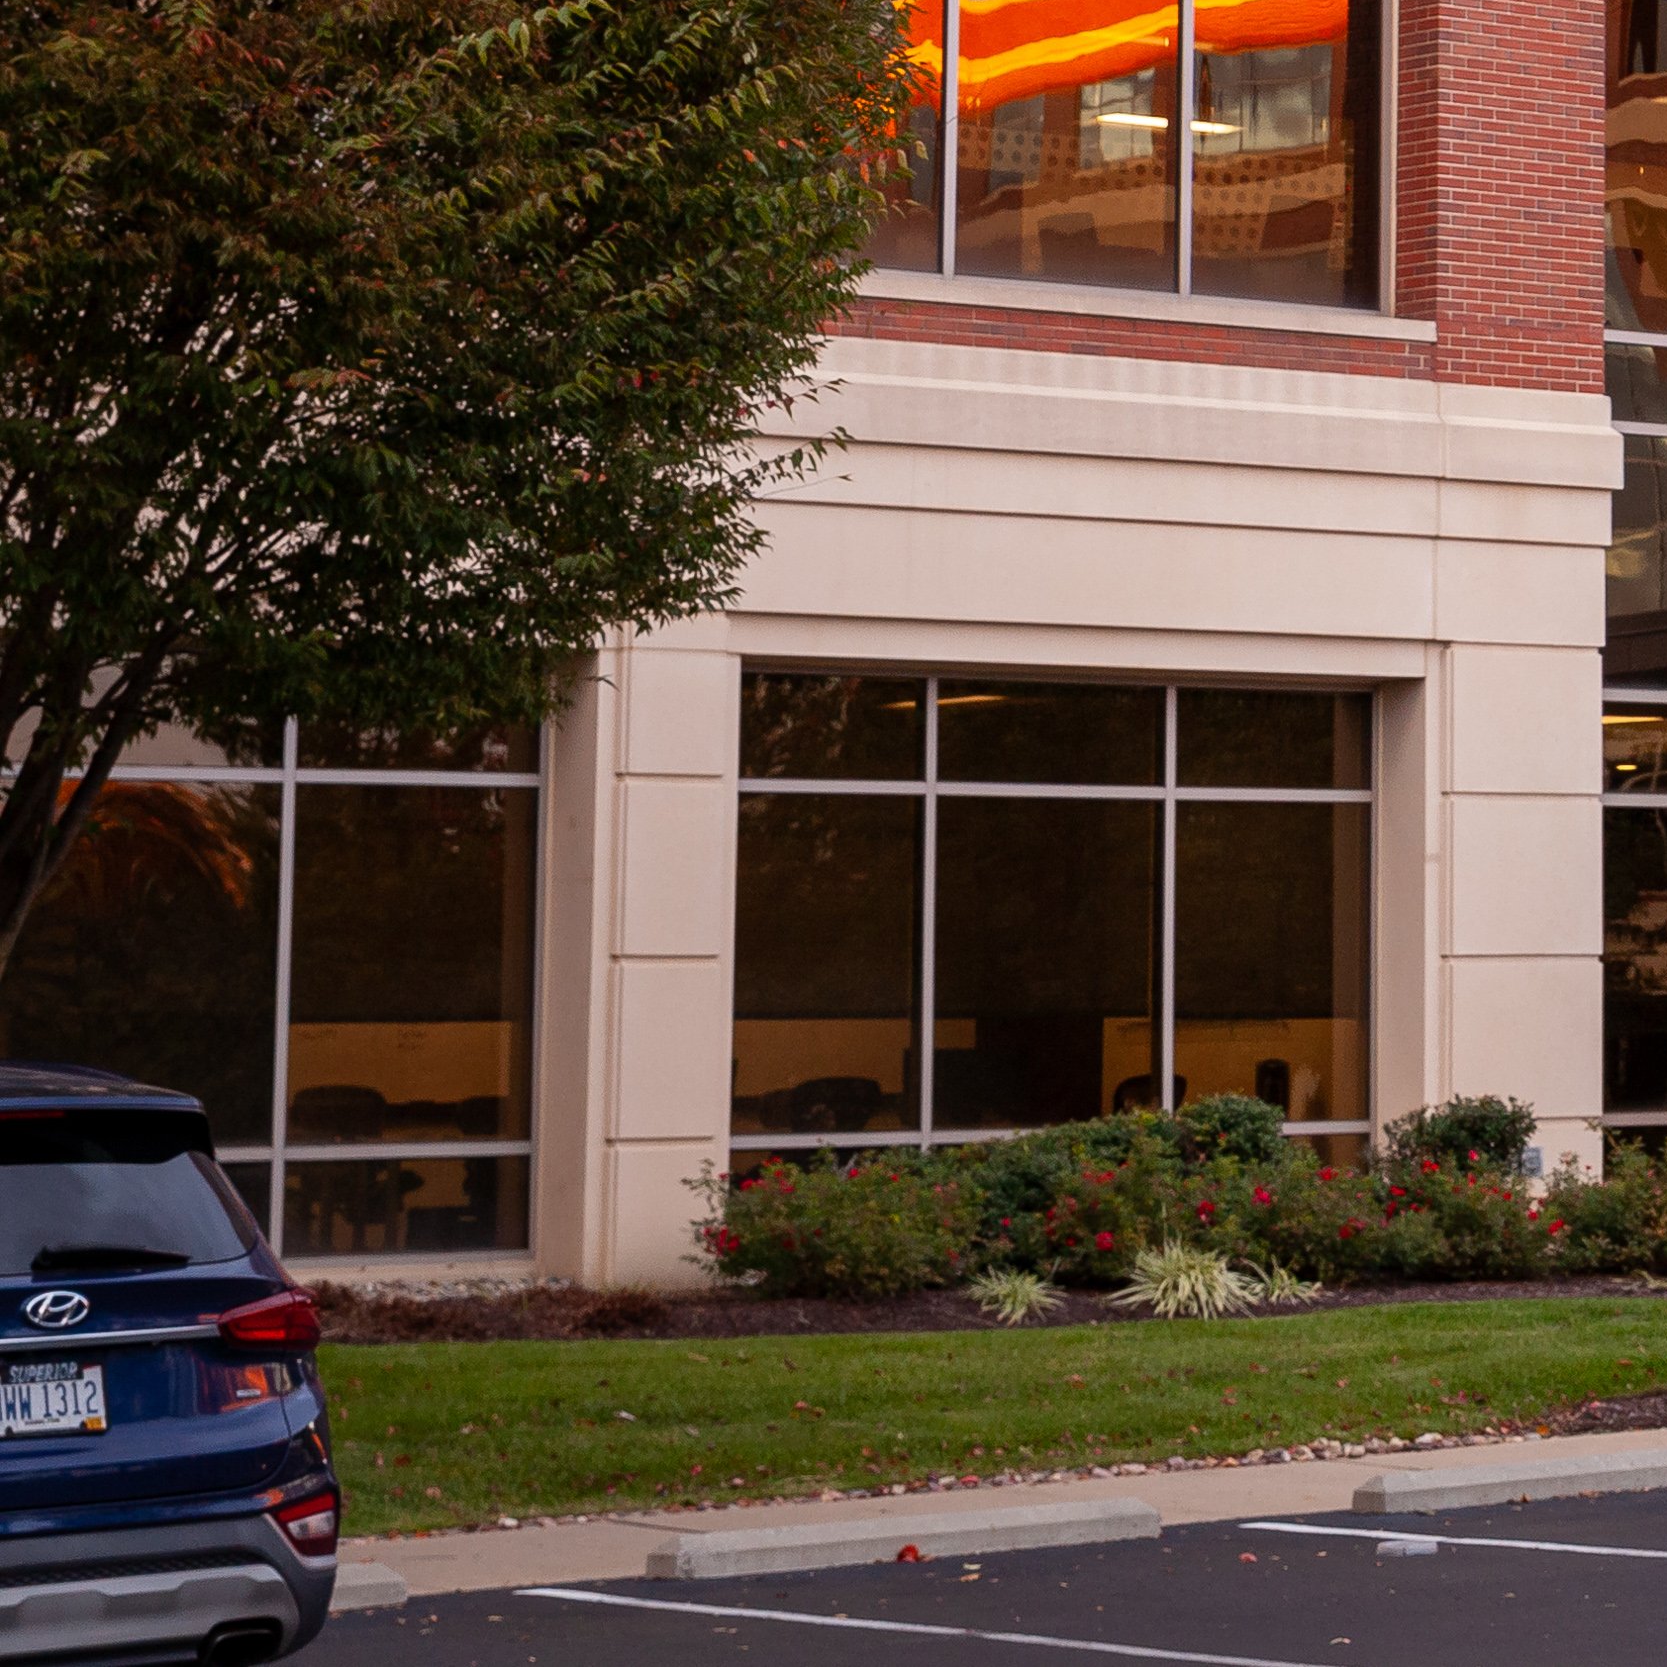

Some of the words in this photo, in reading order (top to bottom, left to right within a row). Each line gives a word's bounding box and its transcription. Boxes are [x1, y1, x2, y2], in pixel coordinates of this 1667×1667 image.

[10, 1362, 78, 1383] SUPERIOR
[0, 1385, 31, 1422] WW
[43, 1380, 99, 1418] 1312
